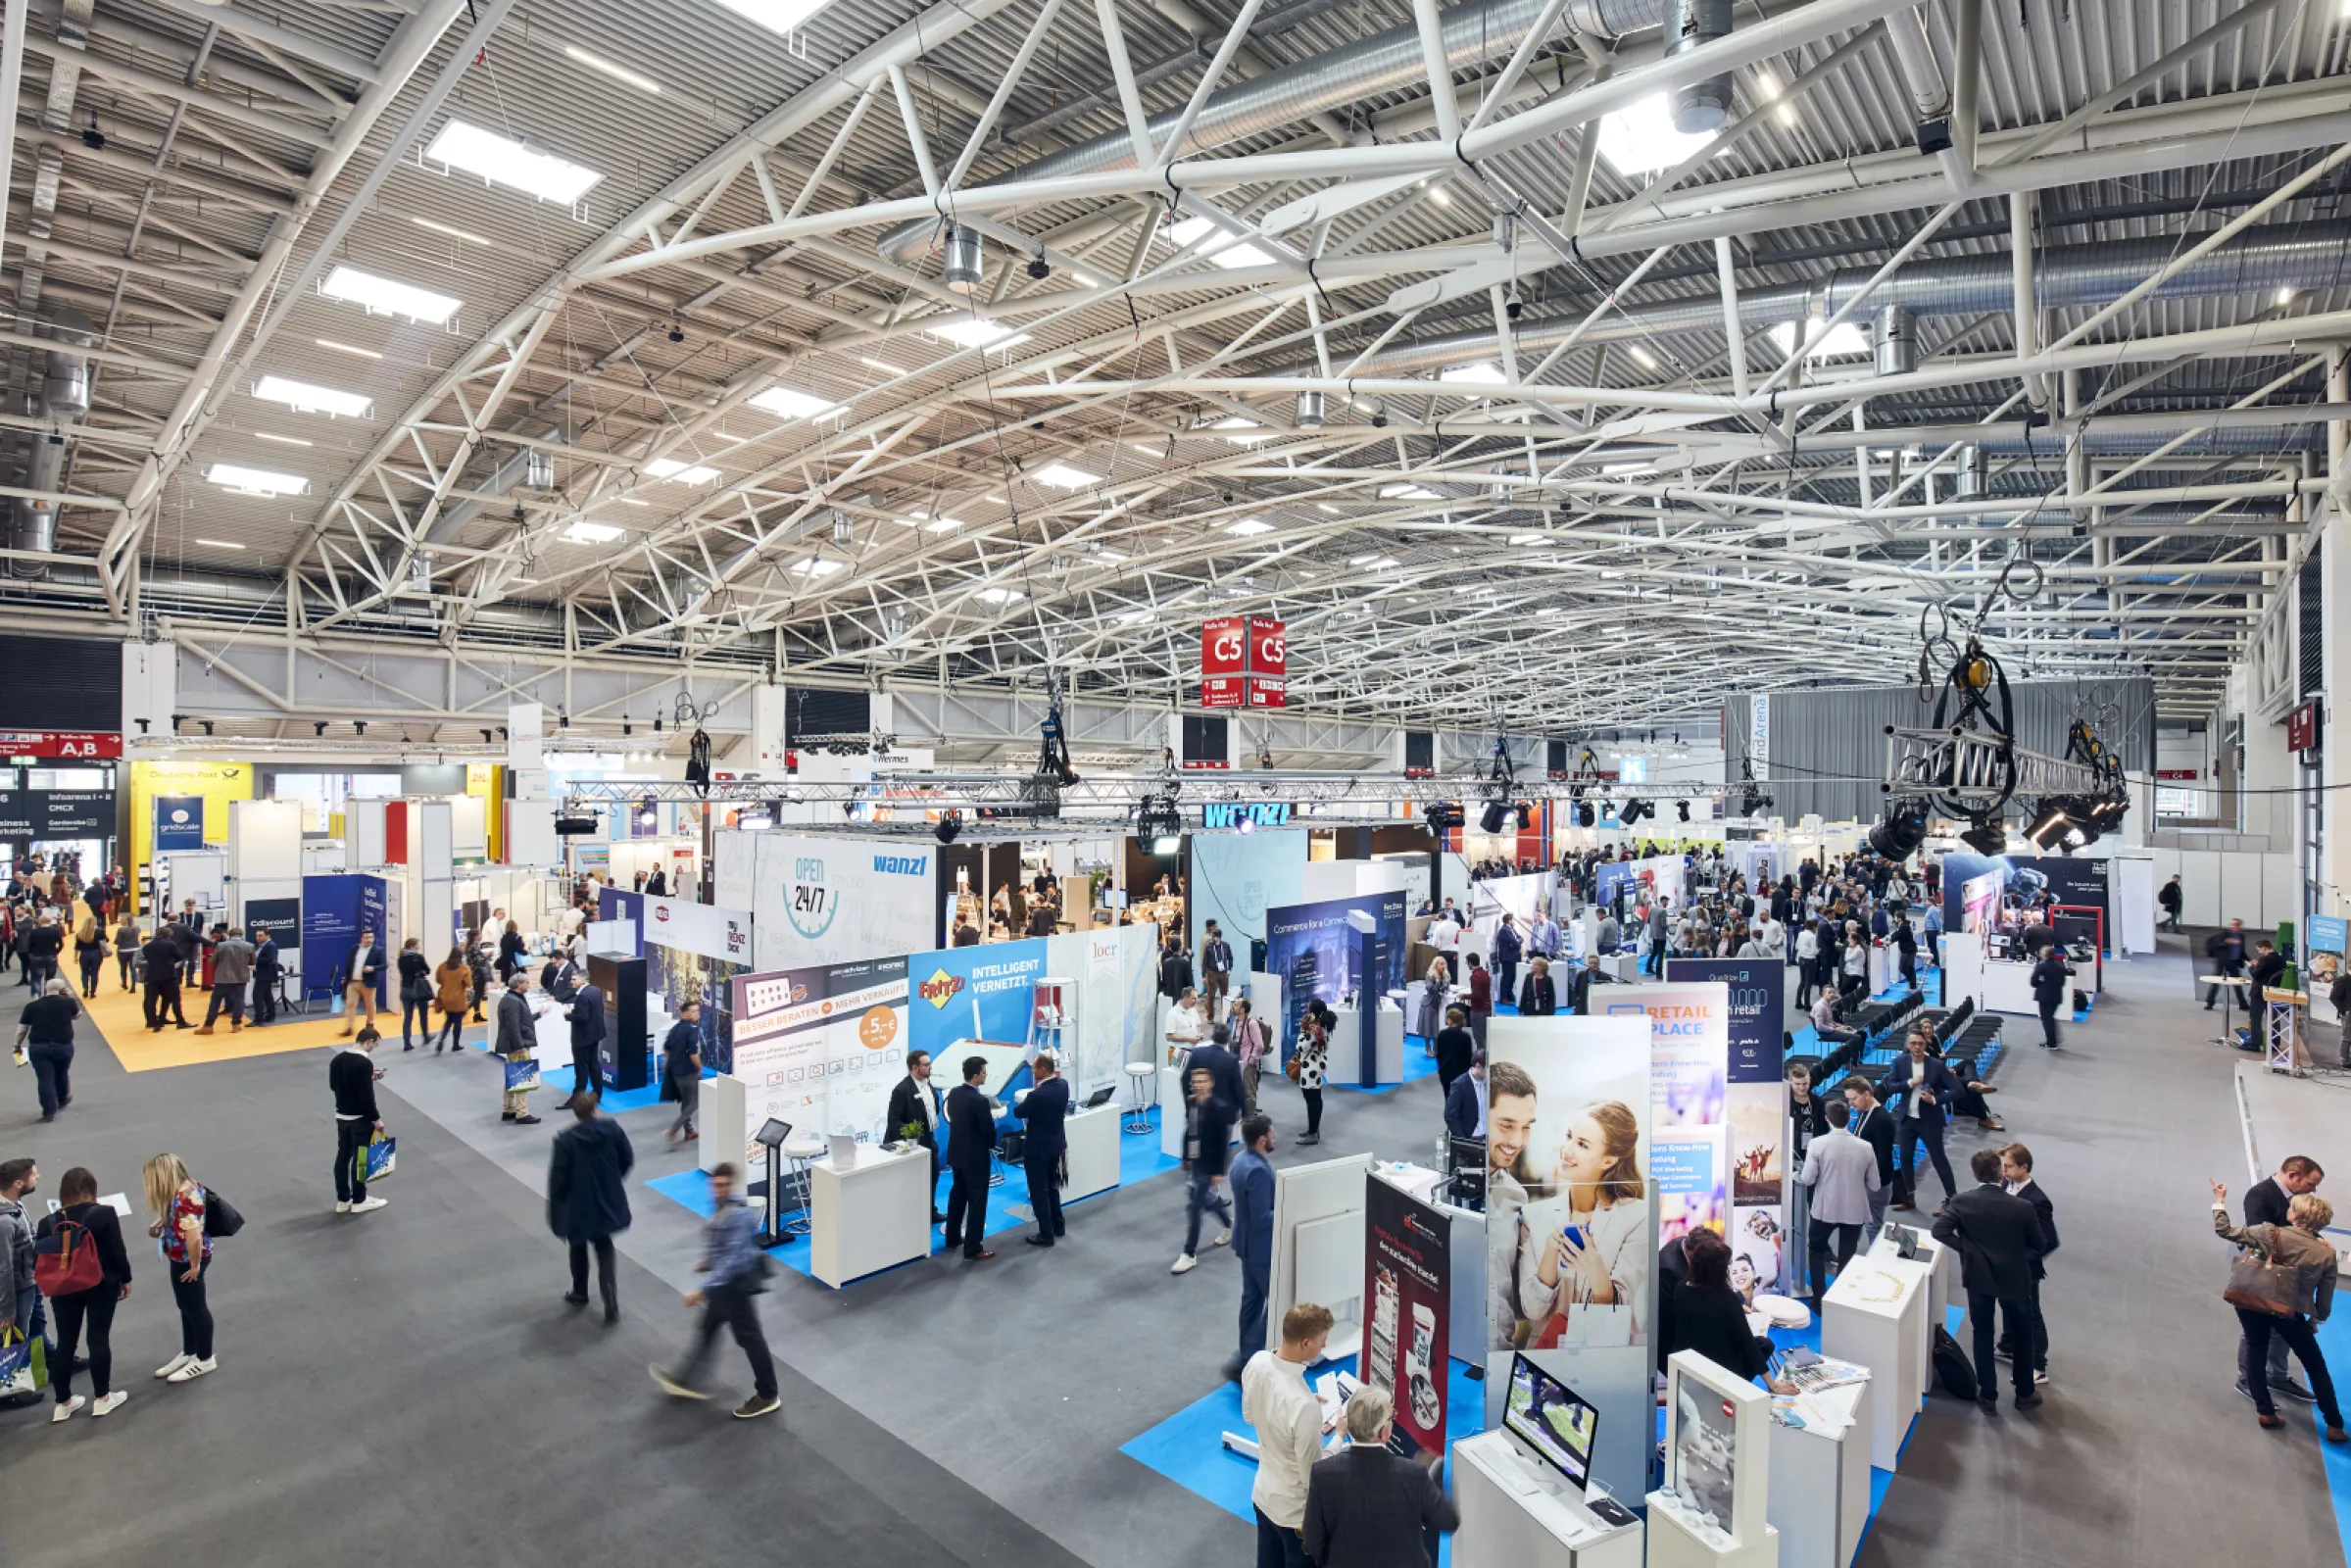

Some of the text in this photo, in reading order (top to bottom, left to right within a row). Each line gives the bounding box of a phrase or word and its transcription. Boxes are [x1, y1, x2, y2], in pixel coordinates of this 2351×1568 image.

[1214, 636, 1242, 662] C5
[1261, 637, 1284, 663] C5
[1754, 698, 1767, 776] Trend Arena
[61, 742, 97, 757] A,B
[878, 755, 909, 763] Hermes
[1624, 760, 1643, 783] K
[160, 823, 200, 832] gridscale
[796, 858, 824, 883] OPEN
[873, 856, 927, 876] wanzl
[795, 885, 825, 913] 24/7
[728, 921, 738, 932] my
[1274, 922, 1308, 934] Commerce
[1308, 919, 1319, 929] for
[728, 931, 745, 944] RENZ
[728, 943, 740, 954] box
[1094, 943, 1116, 957] locr
[972, 959, 1039, 979] INTELLIGENT
[918, 976, 965, 1000] FRITZ!
[972, 976, 1028, 994] VERNETZT.
[739, 984, 905, 1034] BESSER BERATEN MEHR VERKAUFT
[1647, 1005, 1711, 1019] RETAIL
[1735, 1004, 1761, 1015] retail
[1651, 1022, 1703, 1035] PLACE
